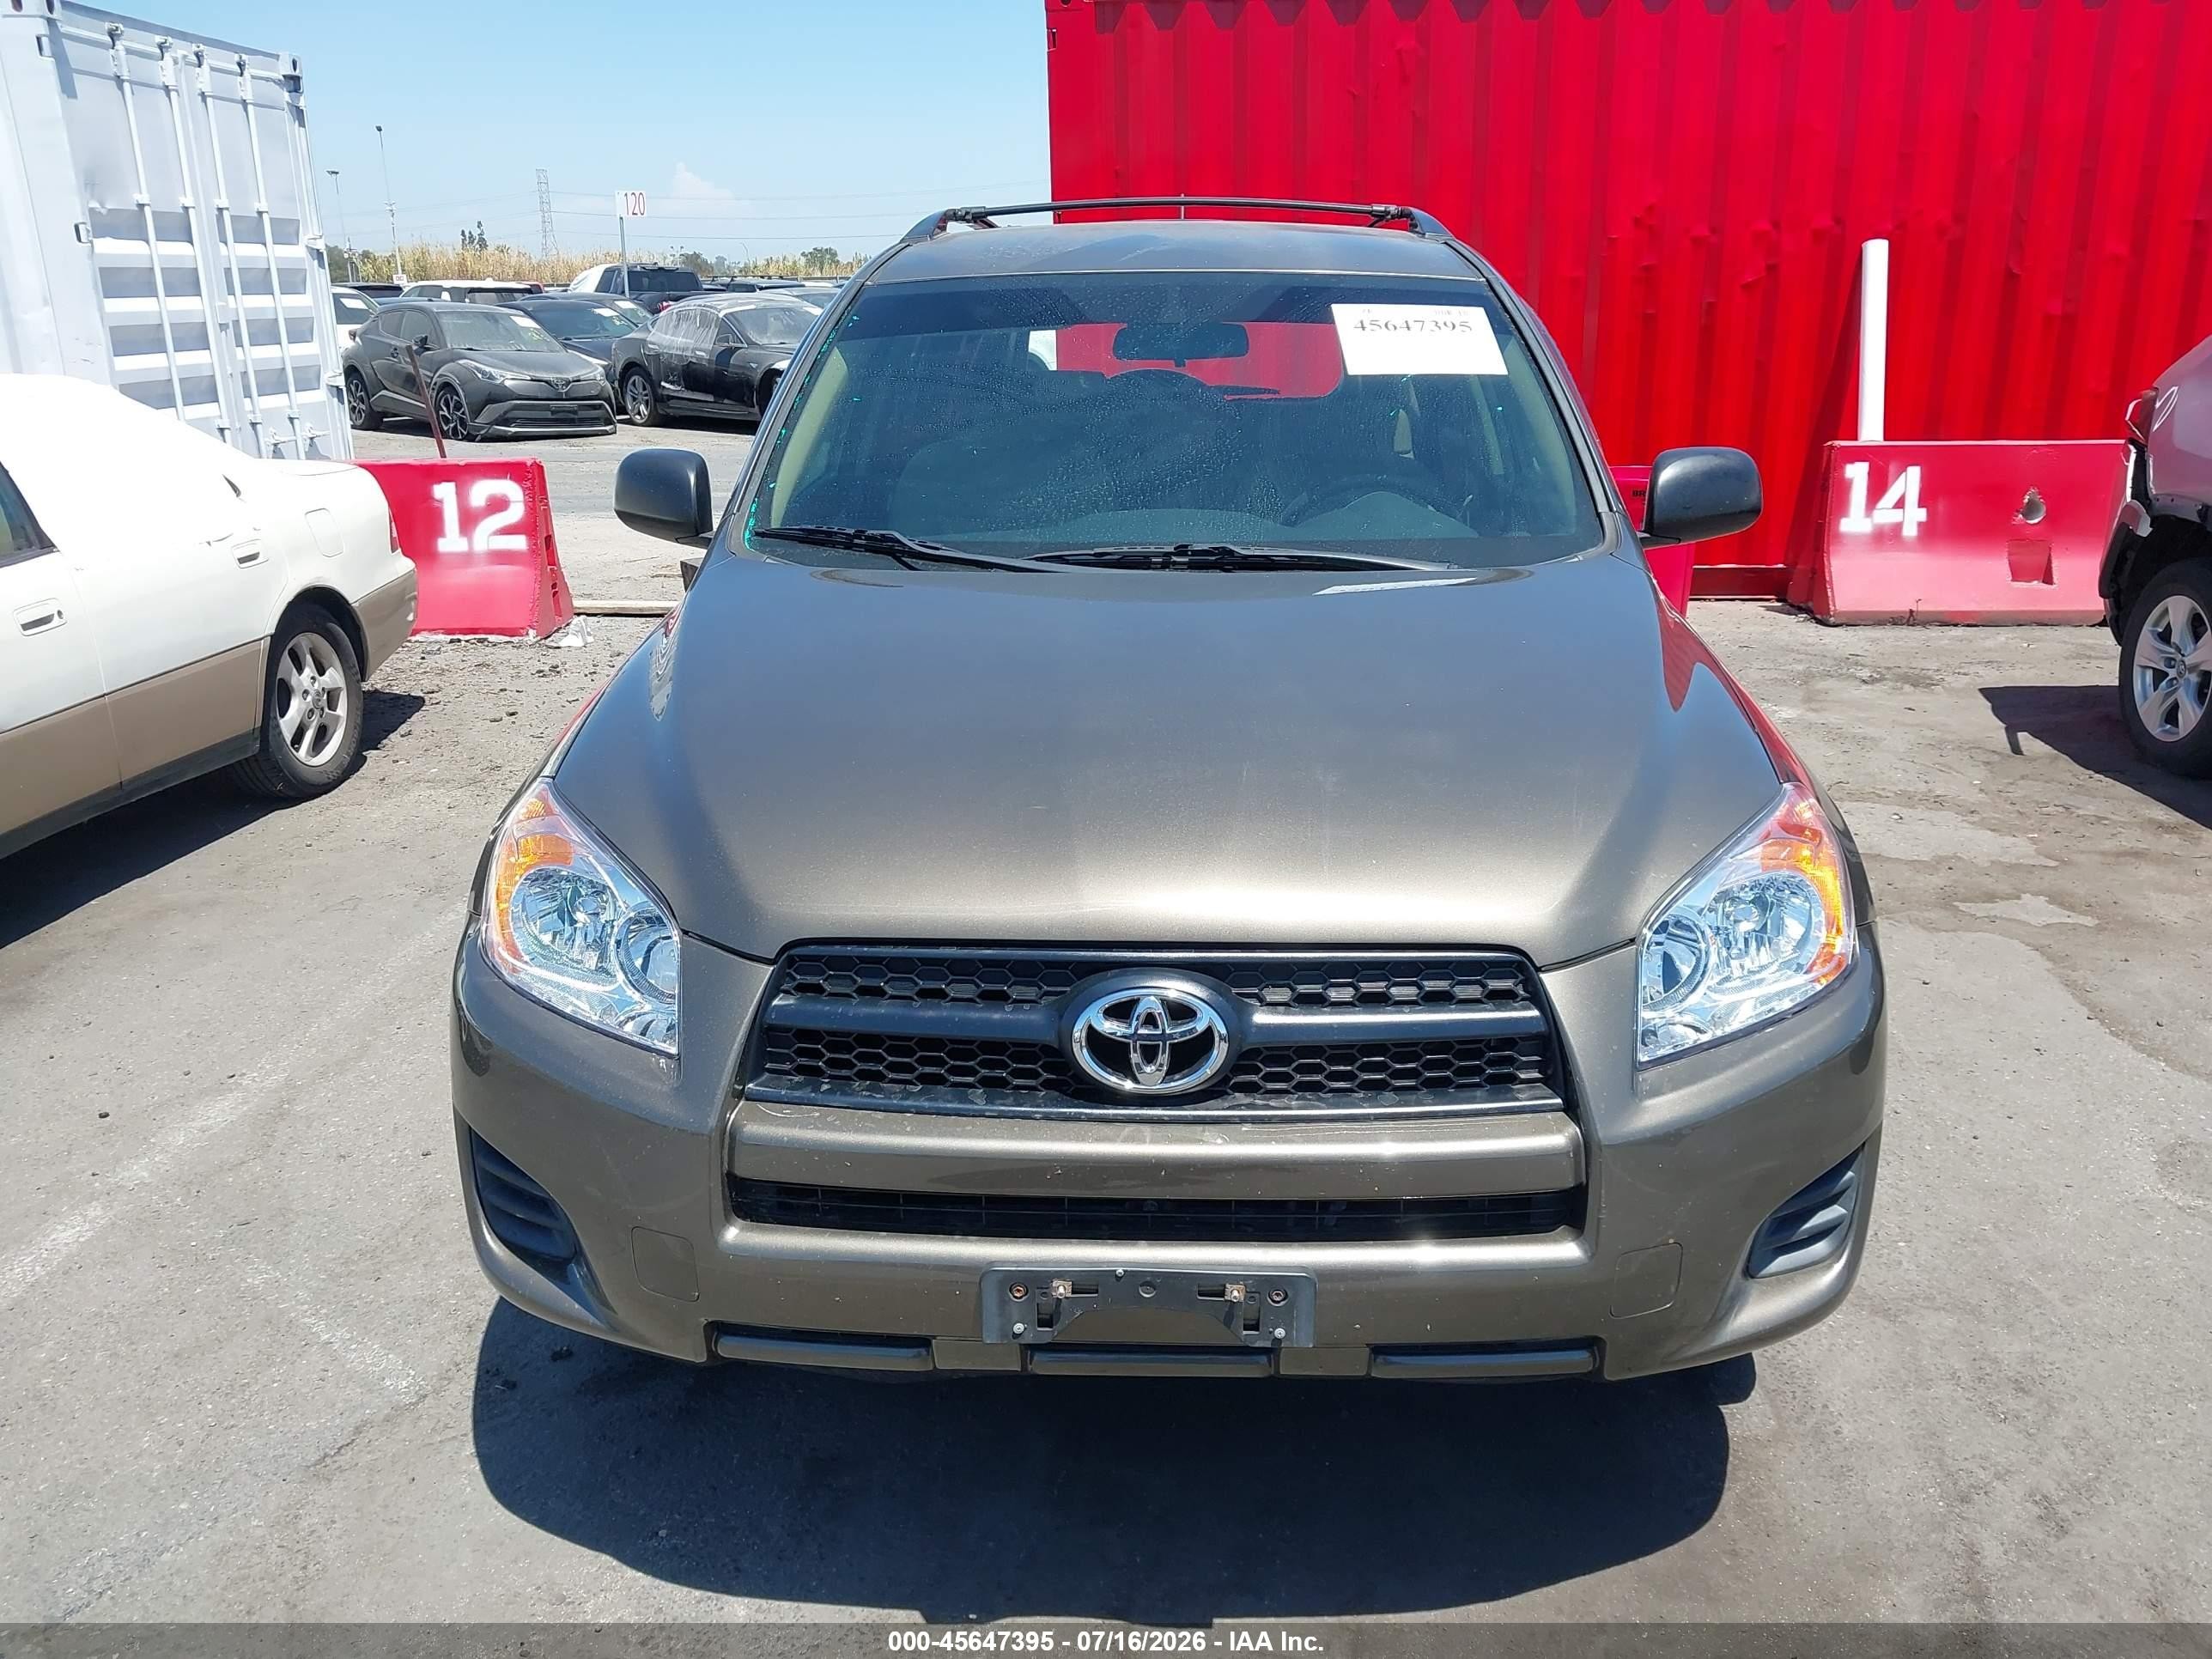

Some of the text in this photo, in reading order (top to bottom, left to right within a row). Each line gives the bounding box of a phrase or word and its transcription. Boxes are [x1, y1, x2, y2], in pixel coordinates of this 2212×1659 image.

[624, 191, 646, 216] 120
[1353, 319, 1473, 333] 45647395
[432, 478, 528, 553] 12
[1838, 461, 1928, 537] 14
